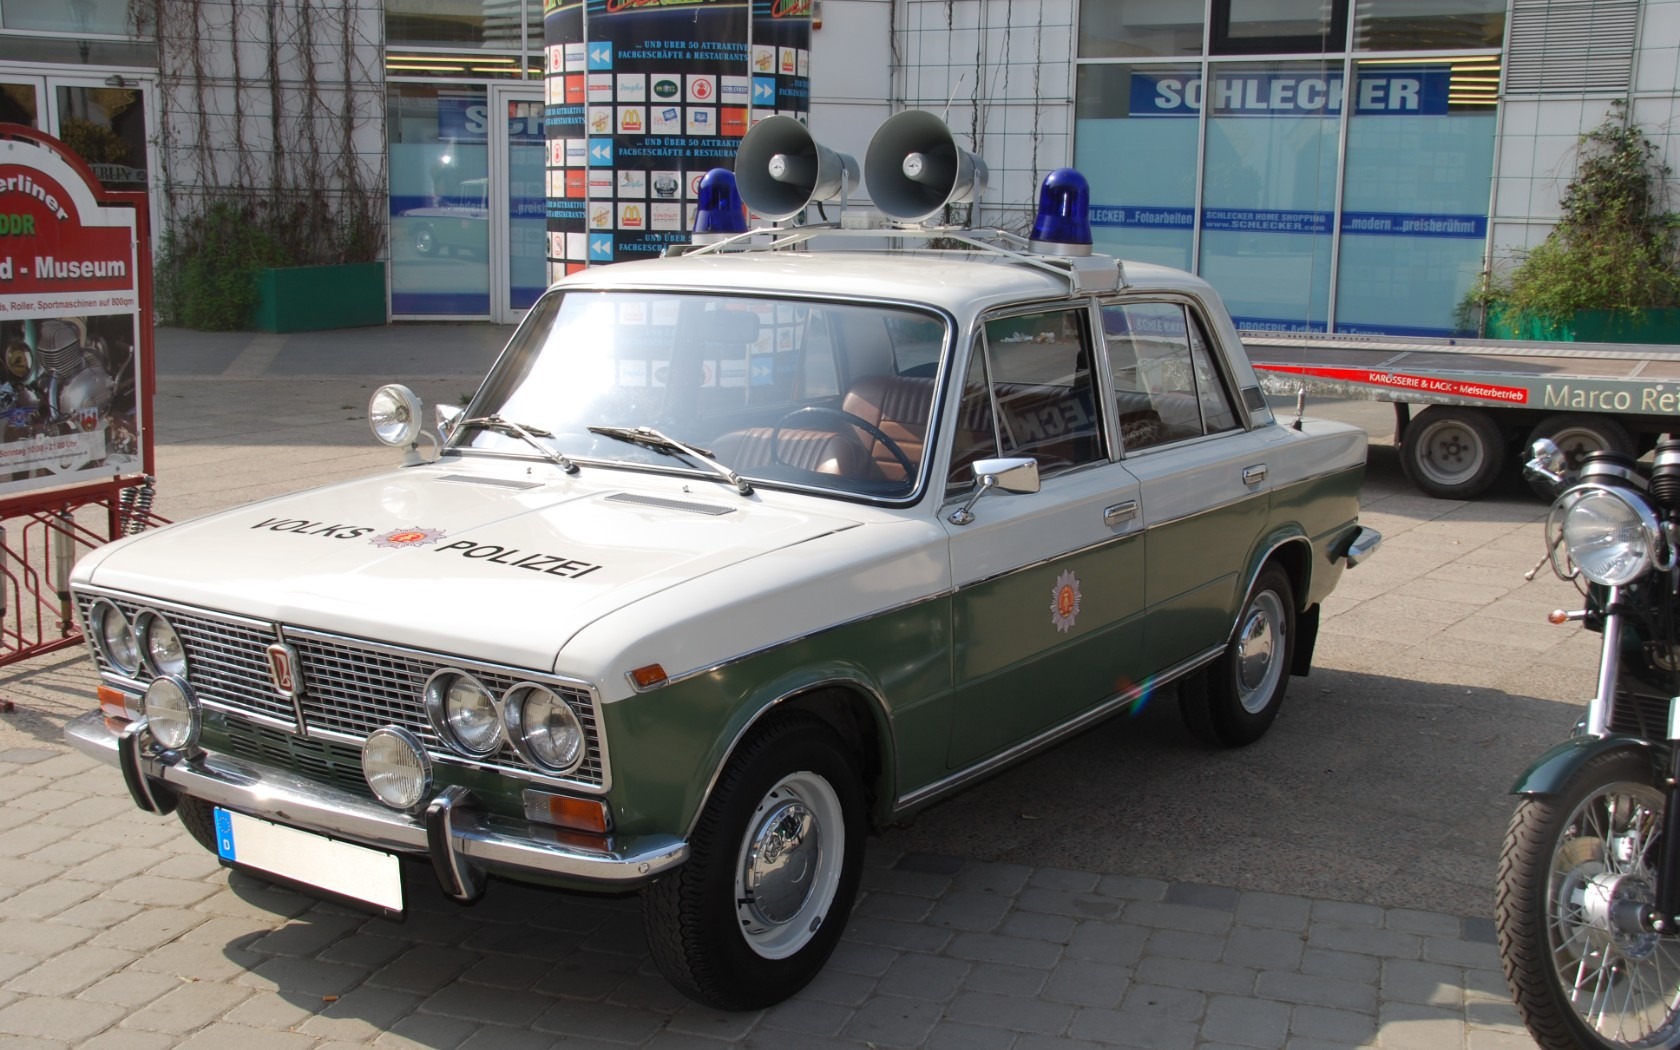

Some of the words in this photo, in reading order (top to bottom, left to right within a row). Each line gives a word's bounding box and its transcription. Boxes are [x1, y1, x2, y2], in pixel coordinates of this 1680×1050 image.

[644, 41, 662, 49] UND
[688, 41, 699, 49] 50
[700, 41, 749, 52] ATTRAKTIVE
[618, 49, 684, 60] FACHGESCHÄFTE
[693, 51, 749, 62] RESTAURANTS
[1155, 77, 1420, 110] SCHLECKER
[644, 138, 662, 146] UND
[664, 136, 687, 147] ÜBER
[618, 146, 684, 157] FACHGESCHÄFTE
[685, 149, 692, 157] &
[1206, 210, 1254, 221] SCHLECKER
[1255, 213, 1280, 222] HOME
[1281, 214, 1326, 223] SHOPPING
[35, 255, 127, 279] Museum
[11, 301, 36, 312] Roller,
[37, 299, 98, 312] Sportmaschinen
[98, 299, 110, 308] auf
[111, 297, 135, 308] 800qm
[1420, 379, 1428, 388] &
[1429, 380, 1452, 392] LACK
[1459, 384, 1524, 402] Meisterbetrieb
[1543, 383, 1632, 411] Marco
[250, 517, 376, 540] VOLKS
[433, 540, 604, 580] POLIZEI
[223, 838, 231, 851] D
